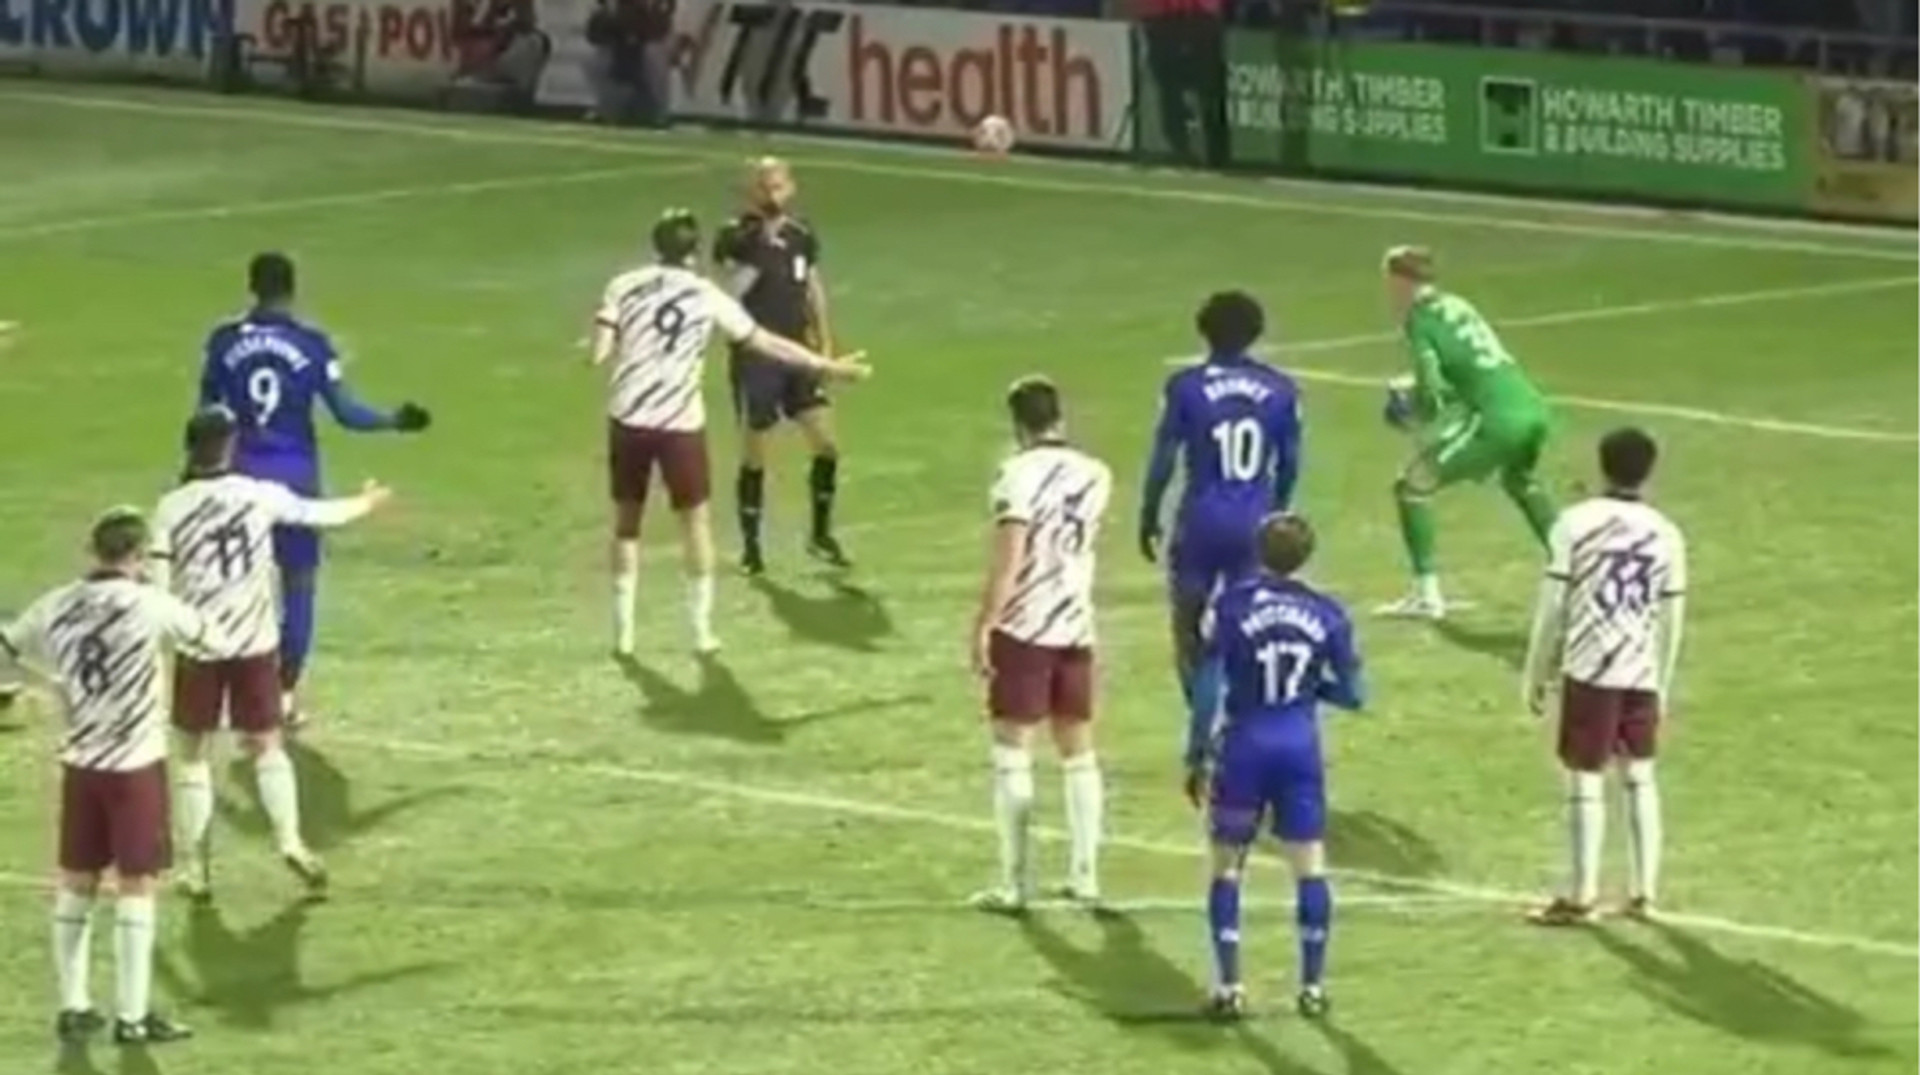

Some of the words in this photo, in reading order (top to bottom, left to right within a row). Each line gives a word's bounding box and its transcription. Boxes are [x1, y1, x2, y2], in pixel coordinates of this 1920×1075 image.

[848, 14, 1099, 136] health
[1352, 71, 1445, 109] TIMBER
[1543, 87, 1675, 128] HOWARTH
[1682, 98, 1783, 137] TIMBER
[1674, 134, 1786, 171] SUPPLIES
[249, 367, 280, 426] 9
[1212, 418, 1263, 481] 10
[1256, 641, 1312, 704] 17
